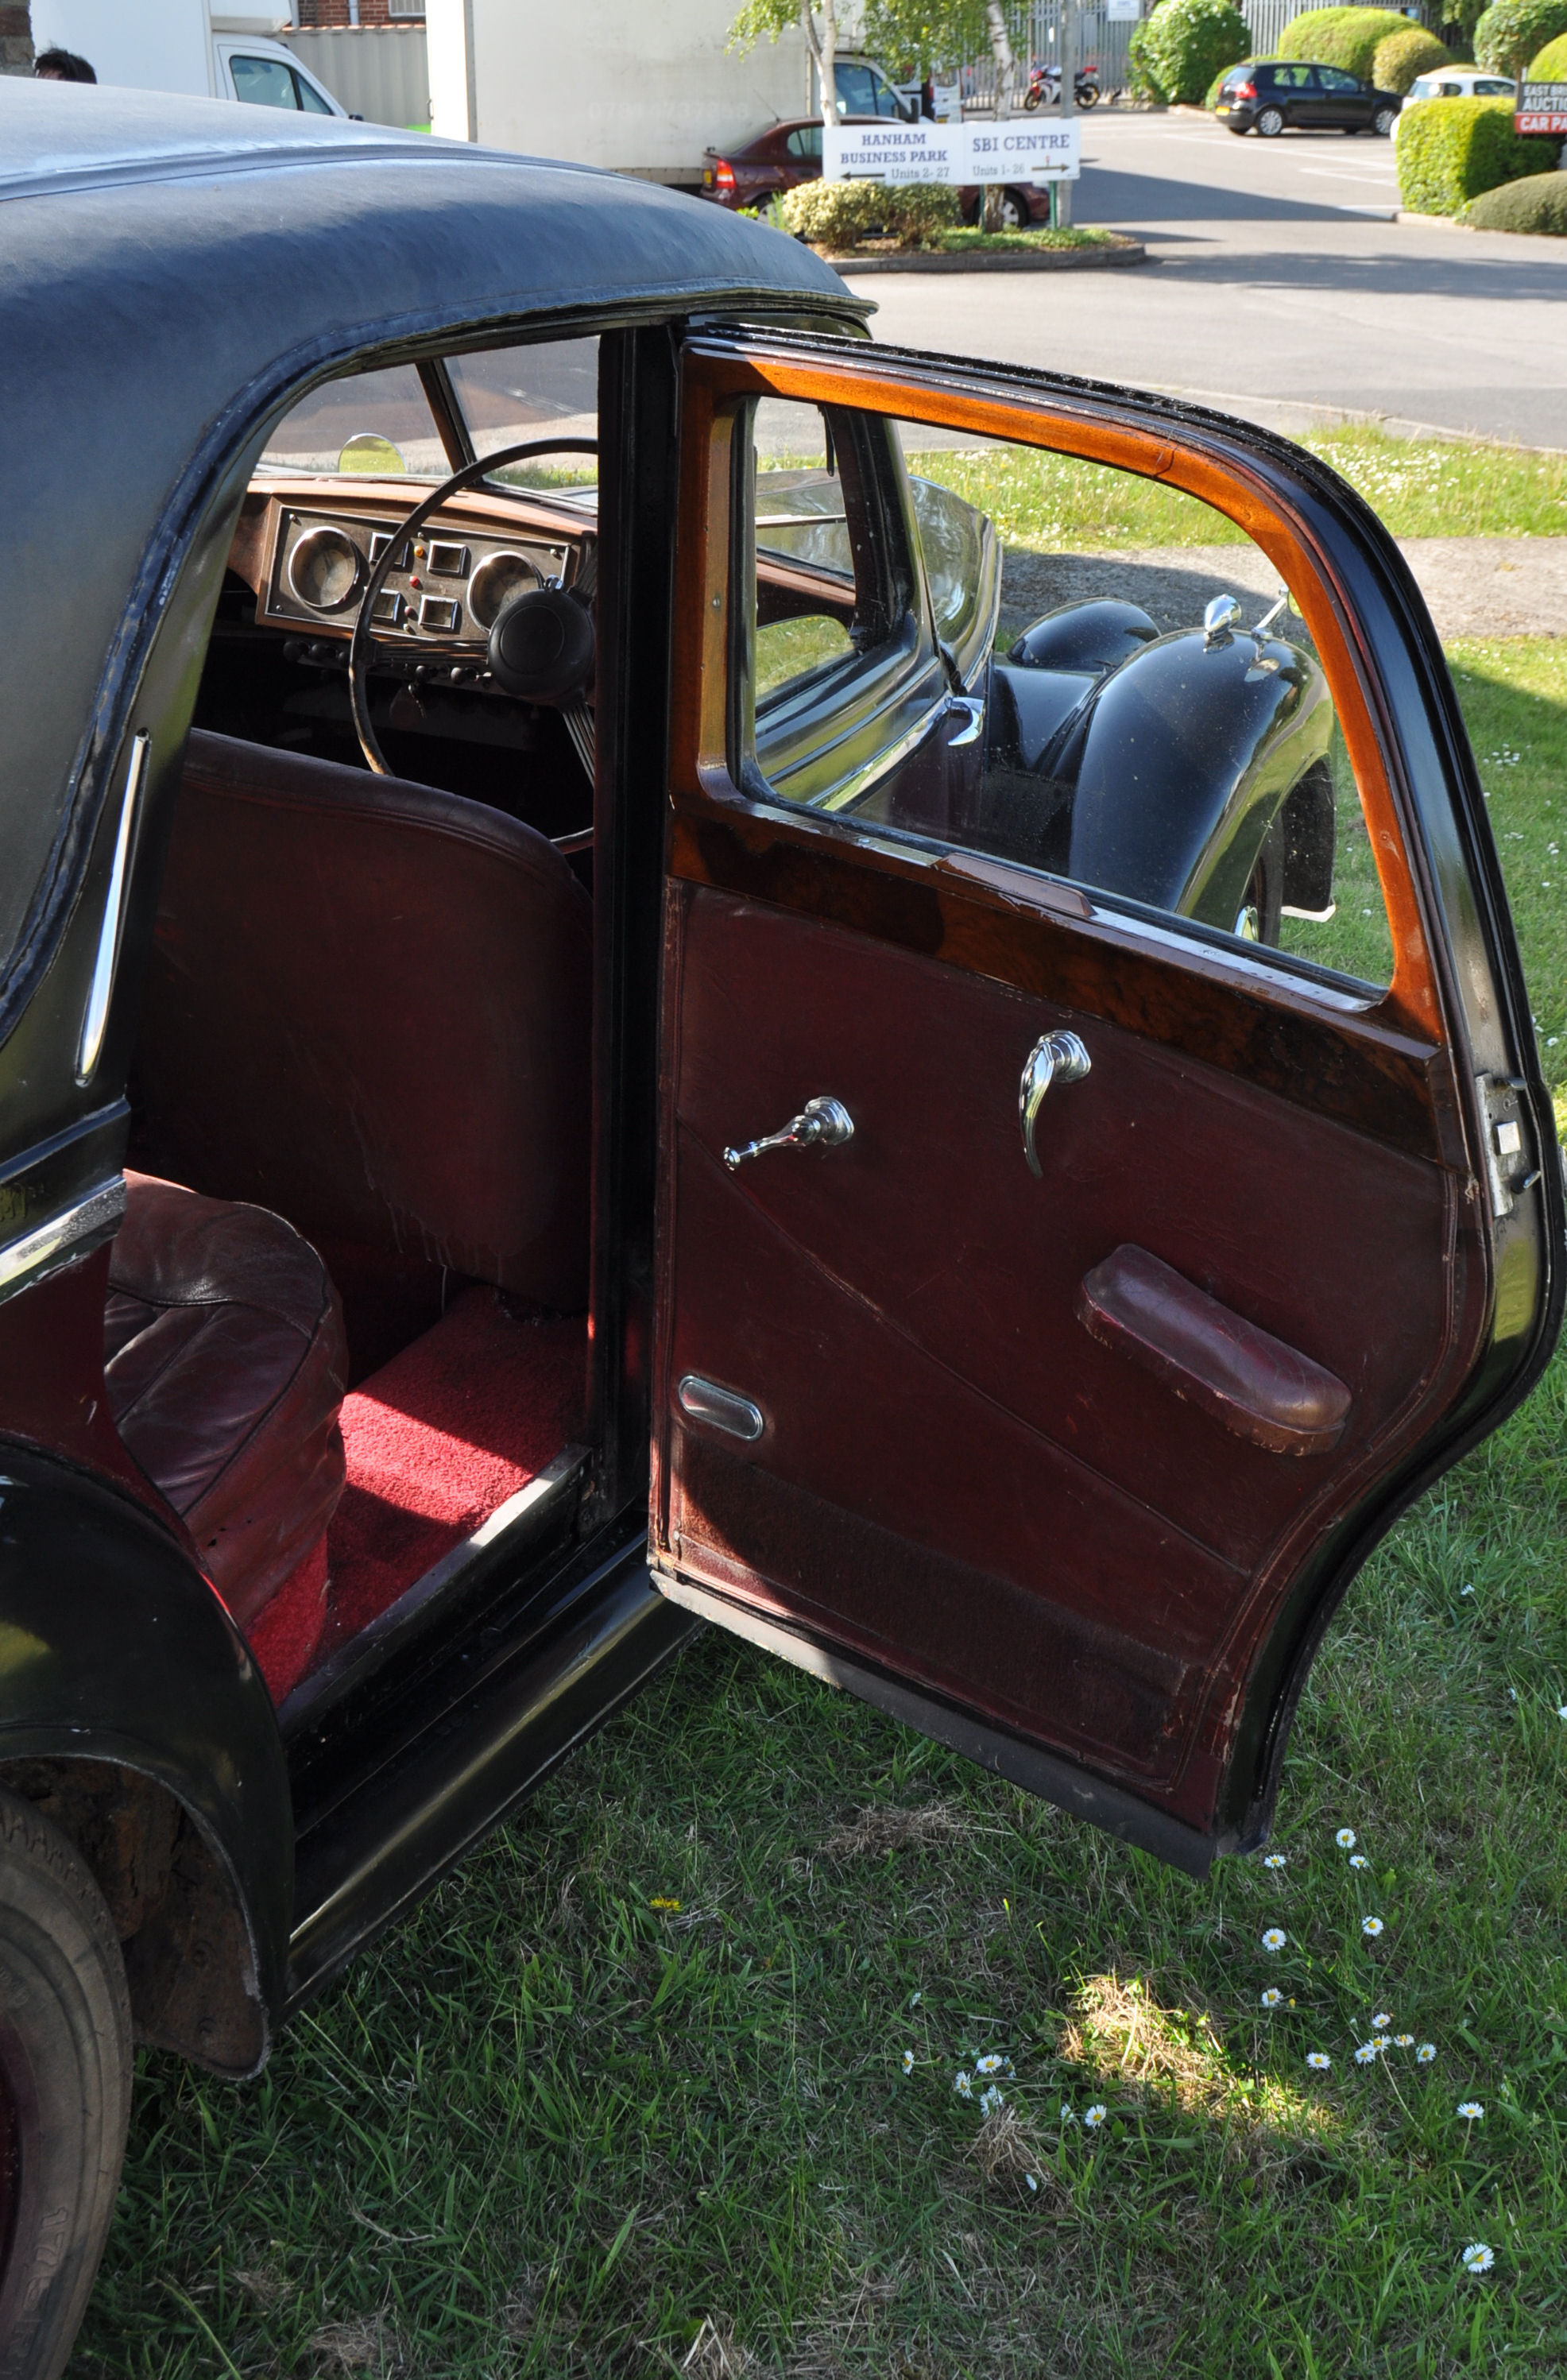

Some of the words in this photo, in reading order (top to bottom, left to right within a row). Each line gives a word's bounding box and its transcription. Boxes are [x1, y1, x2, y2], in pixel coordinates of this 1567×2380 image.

[1523, 84, 1550, 96] EAST
[1520, 116, 1549, 132] CAR
[861, 134, 927, 146] HANHAM
[973, 137, 999, 153] SBI
[1004, 134, 1070, 151] CENTRE
[841, 151, 907, 164] BUSINESS
[910, 149, 948, 162] PARK
[891, 168, 920, 180] Units
[973, 165, 998, 176] Units
